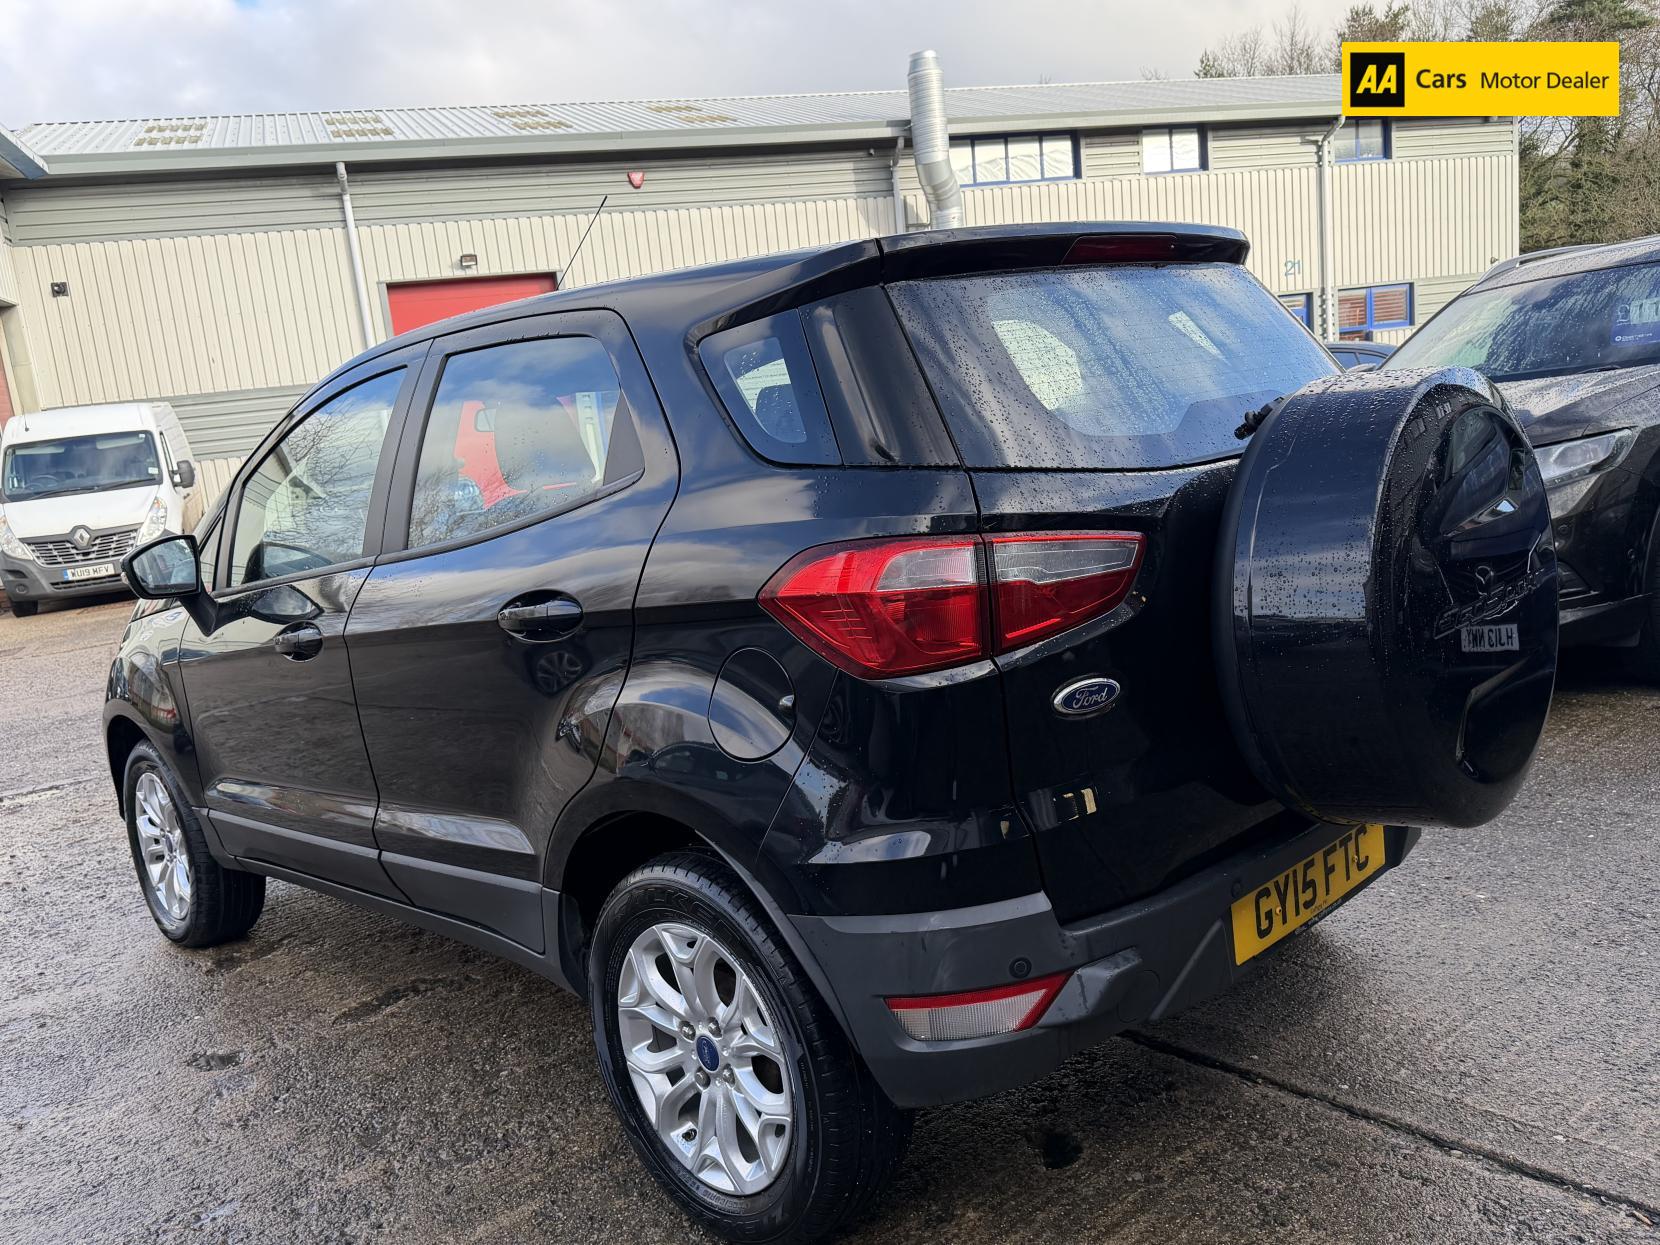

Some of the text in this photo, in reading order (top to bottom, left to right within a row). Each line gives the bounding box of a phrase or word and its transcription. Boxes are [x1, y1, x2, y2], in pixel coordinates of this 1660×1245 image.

[1284, 259, 1301, 277] 21
[1072, 685, 1108, 709] Ford
[1254, 857, 1317, 939] GY15
[1322, 823, 1369, 896] FTC
